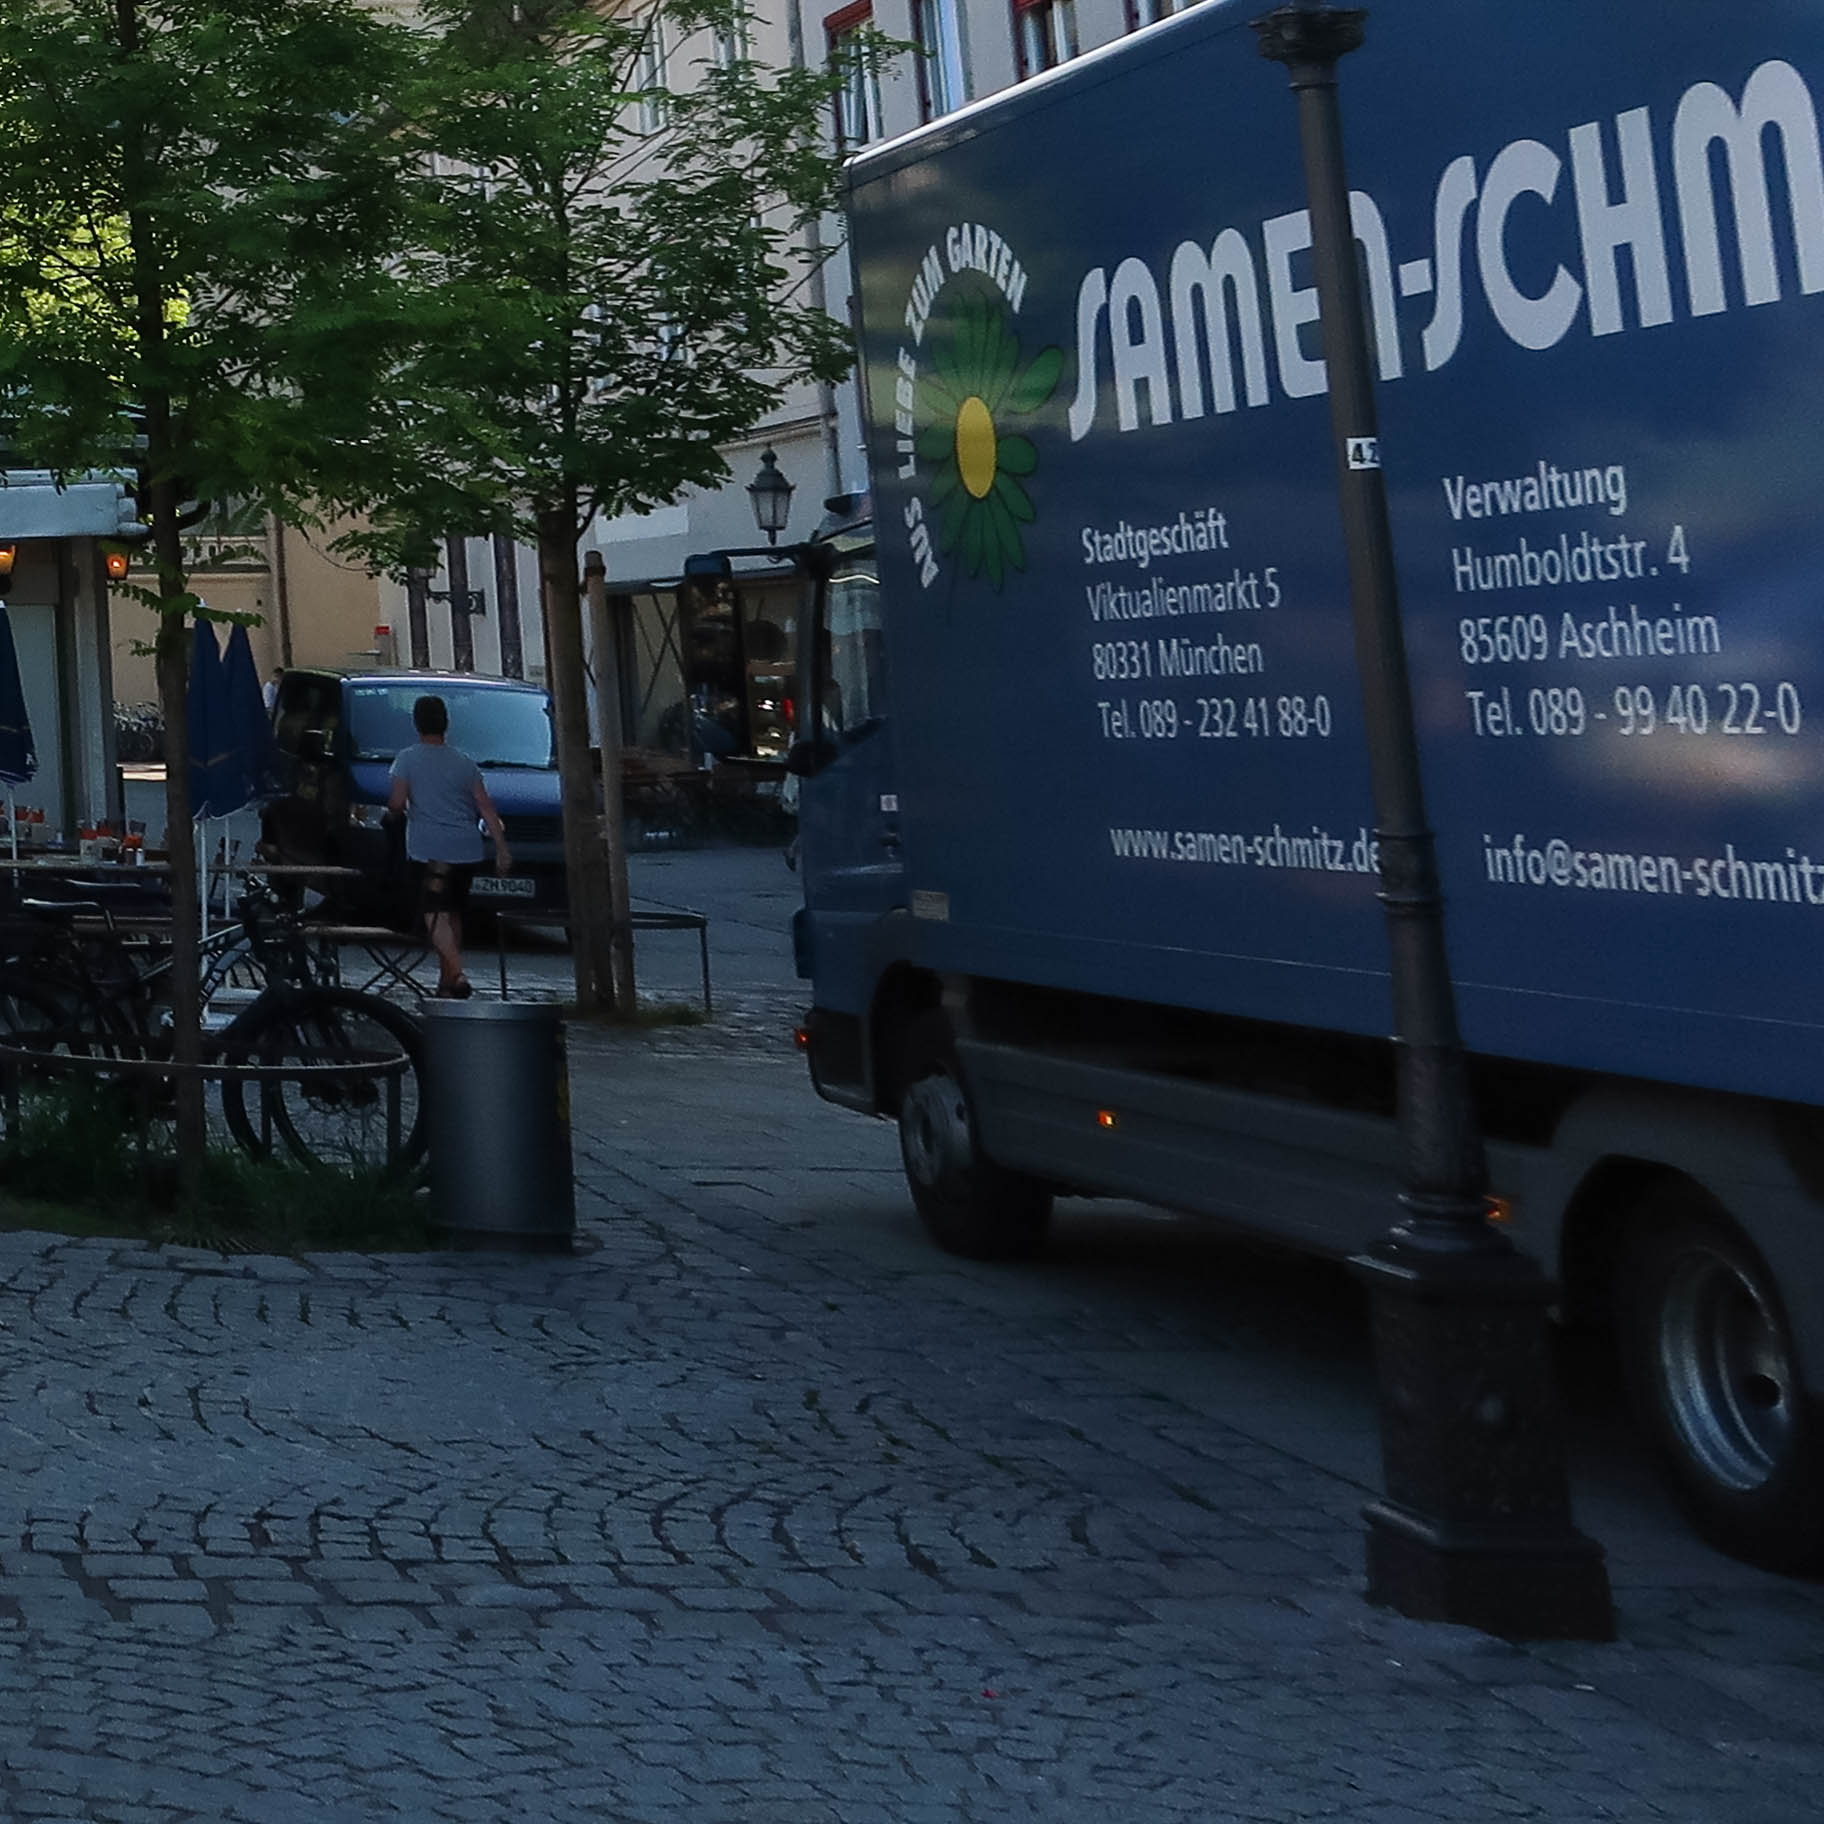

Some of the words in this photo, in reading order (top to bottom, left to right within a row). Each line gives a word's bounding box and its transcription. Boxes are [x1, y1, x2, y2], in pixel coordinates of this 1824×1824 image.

[904, 245, 944, 347] ZUM
[946, 222, 1028, 315] GARTEN
[895, 347, 917, 479] LIEBE
[1442, 460, 1628, 520] Verwaltung
[904, 496, 939, 588] AUS
[1082, 507, 1229, 568] Stadtgeschäft
[1452, 530, 1659, 593] Humboldtstr.
[1667, 524, 1692, 574] 4
[1086, 568, 1261, 621] Viktualienmarkt
[1265, 567, 1280, 608] 5
[1092, 640, 1153, 680] 80331
[1158, 632, 1264, 677] München
[1459, 614, 1549, 664] 85609
[1559, 602, 1721, 659] Aschheim
[1097, 699, 1136, 738] Tel.
[1139, 699, 1178, 738] 089
[1196, 697, 1238, 737] 232
[1244, 697, 1270, 736] 41
[1277, 694, 1331, 737] 88-0
[1465, 687, 1523, 737] Tel.
[1528, 687, 1586, 737] 089
[1614, 685, 1655, 736] 99
[1665, 684, 1709, 735] 40
[1717, 682, 1802, 736] 22-0
[1110, 824, 1381, 873] www.samen-schmitz.de
